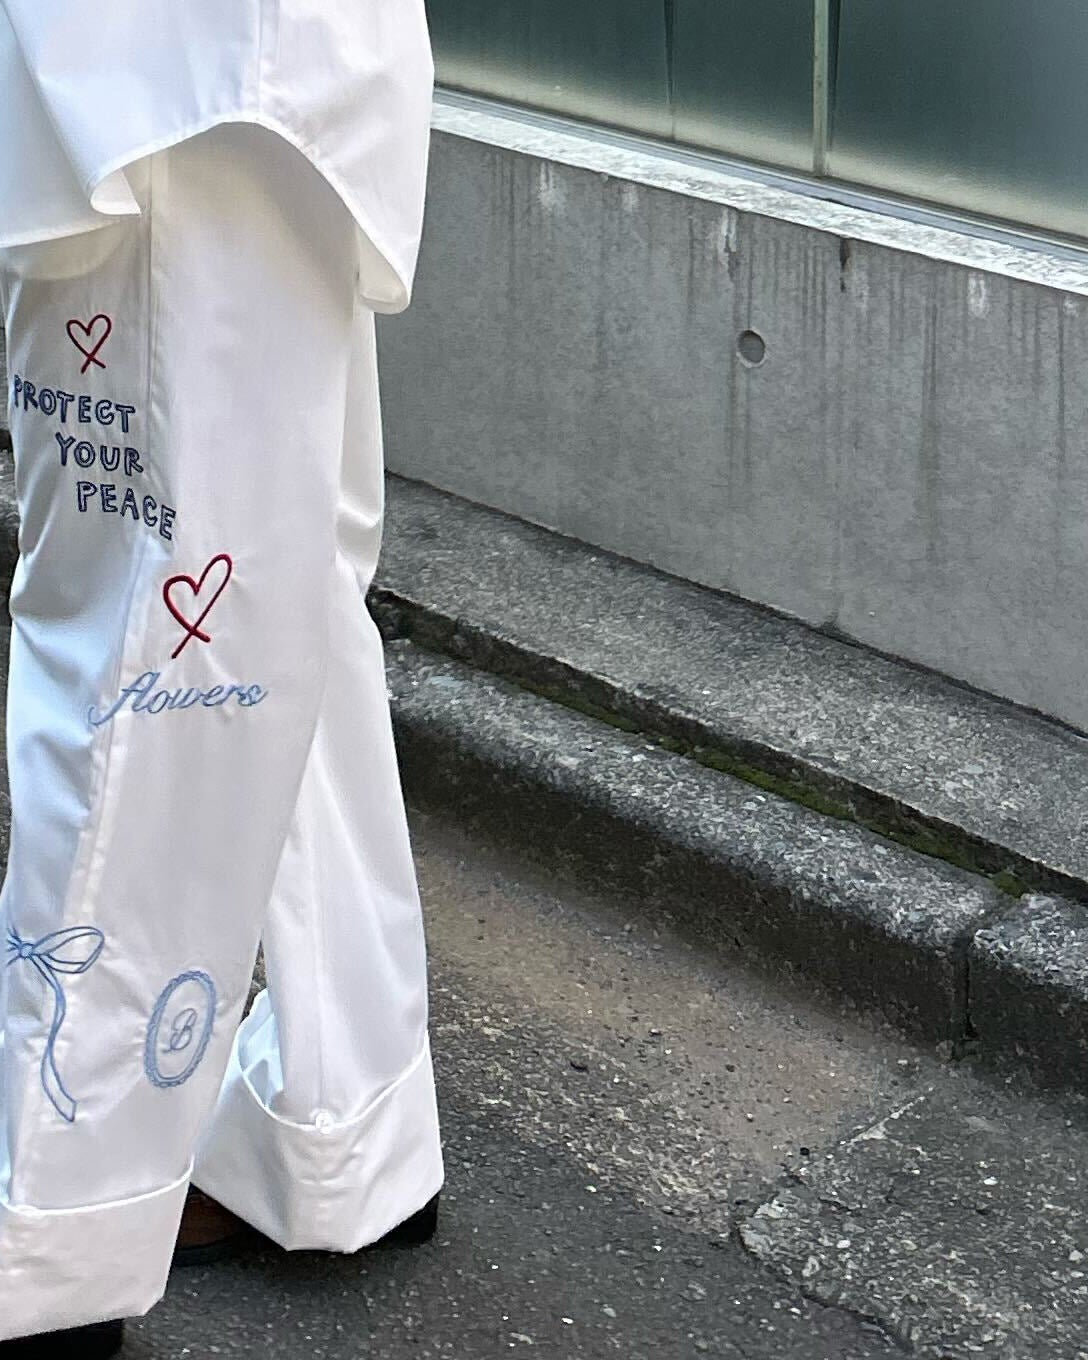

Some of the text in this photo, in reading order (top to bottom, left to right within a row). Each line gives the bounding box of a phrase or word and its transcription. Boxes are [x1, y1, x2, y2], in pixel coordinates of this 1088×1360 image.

[12, 373, 136, 434] PROTECT
[54, 432, 144, 476] YOUR
[76, 481, 177, 542] PEACE
[88, 670, 269, 727] flowers
